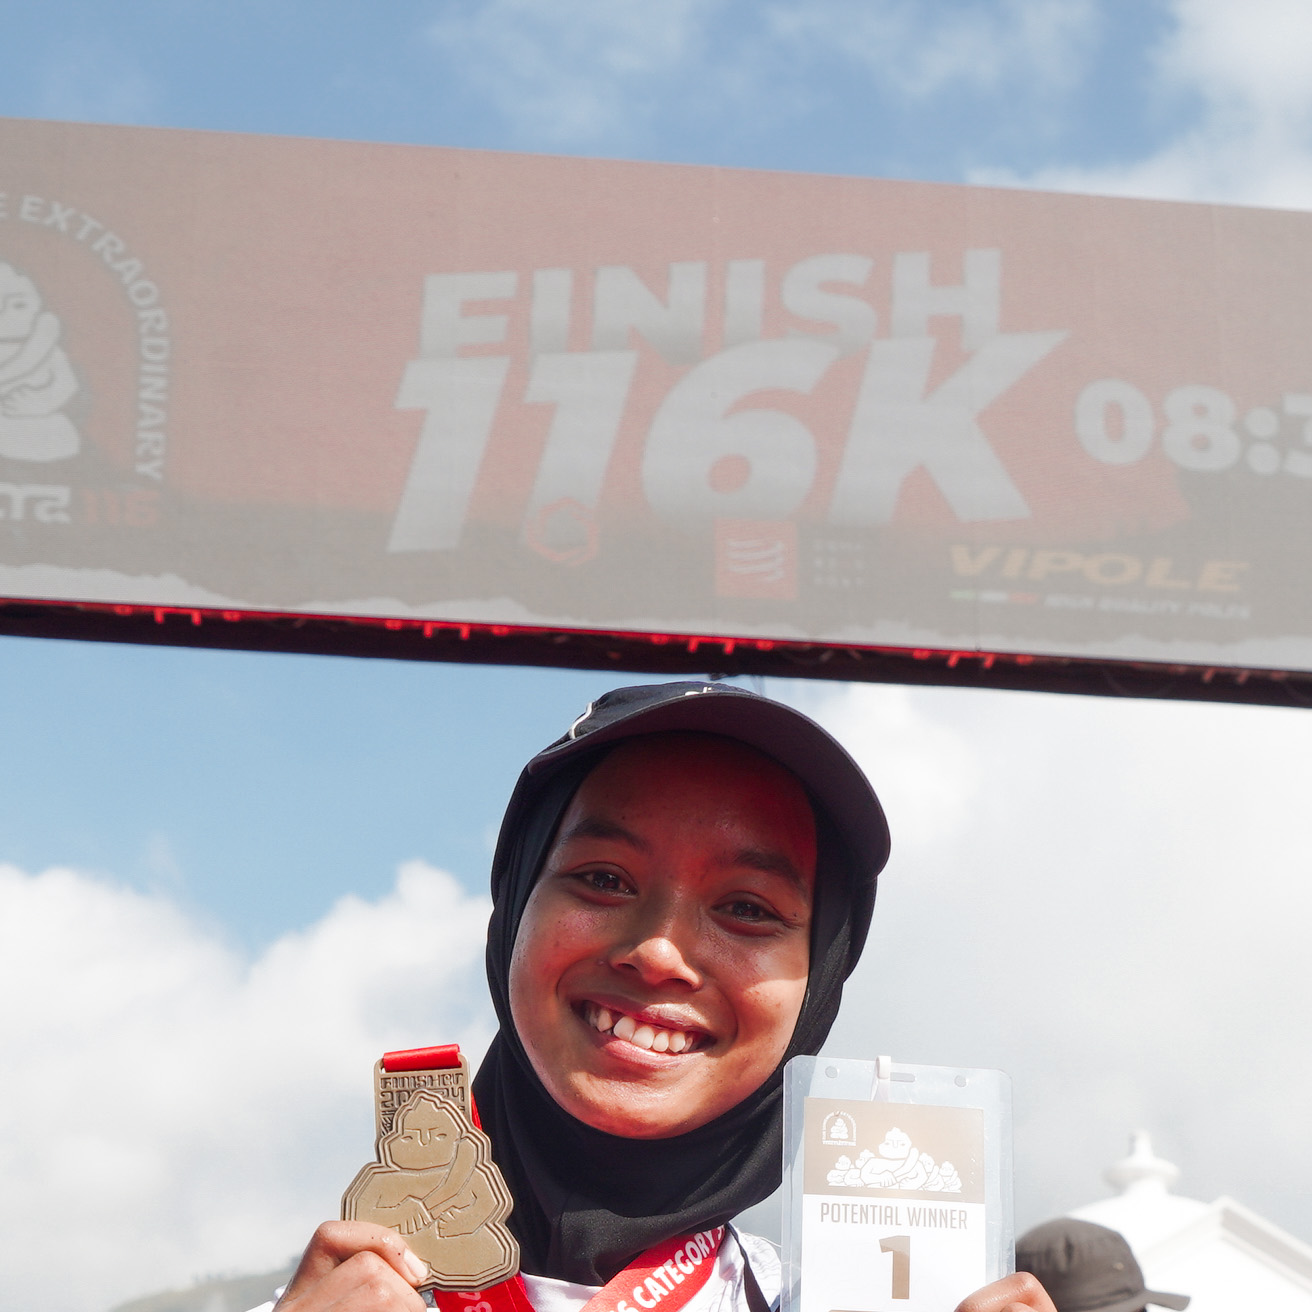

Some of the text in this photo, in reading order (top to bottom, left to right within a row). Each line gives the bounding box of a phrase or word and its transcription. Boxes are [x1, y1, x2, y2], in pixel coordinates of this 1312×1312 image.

[19, 196, 172, 484] EXTRAORDINARY
[420, 248, 1002, 364] FINISH
[387, 330, 1070, 553] 116K
[949, 544, 1250, 592] VIPOLE
[820, 1202, 968, 1230] POTENTIAL WINNER
[633, 1231, 717, 1309] CATEGORY
[878, 1235, 911, 1300] 1
